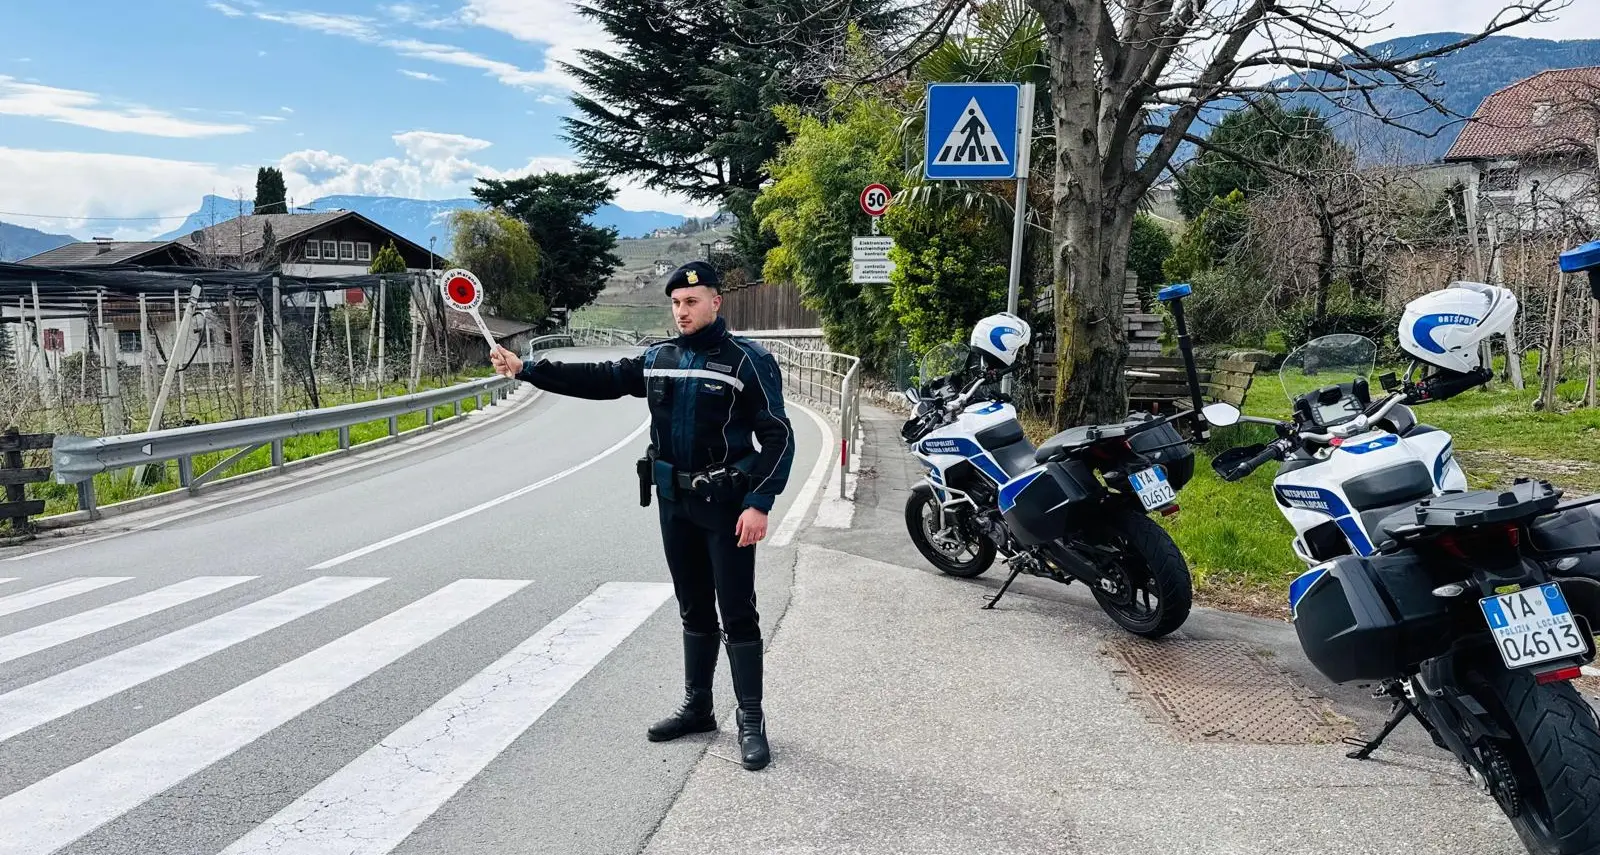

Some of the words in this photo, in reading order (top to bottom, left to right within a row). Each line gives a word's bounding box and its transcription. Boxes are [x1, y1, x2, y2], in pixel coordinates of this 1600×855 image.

[868, 192, 886, 207] 50
[452, 302, 472, 310] POLIZIA
[471, 290, 480, 307] LOCALE
[1137, 471, 1153, 486] YA
[1142, 485, 1174, 507] 04612
[1282, 488, 1320, 499] ORTSPOLIZEI
[1500, 593, 1536, 620] YA
[1499, 624, 1530, 637] POLIZIA
[1537, 615, 1569, 628] LOCALE
[1502, 624, 1580, 661] 04613
